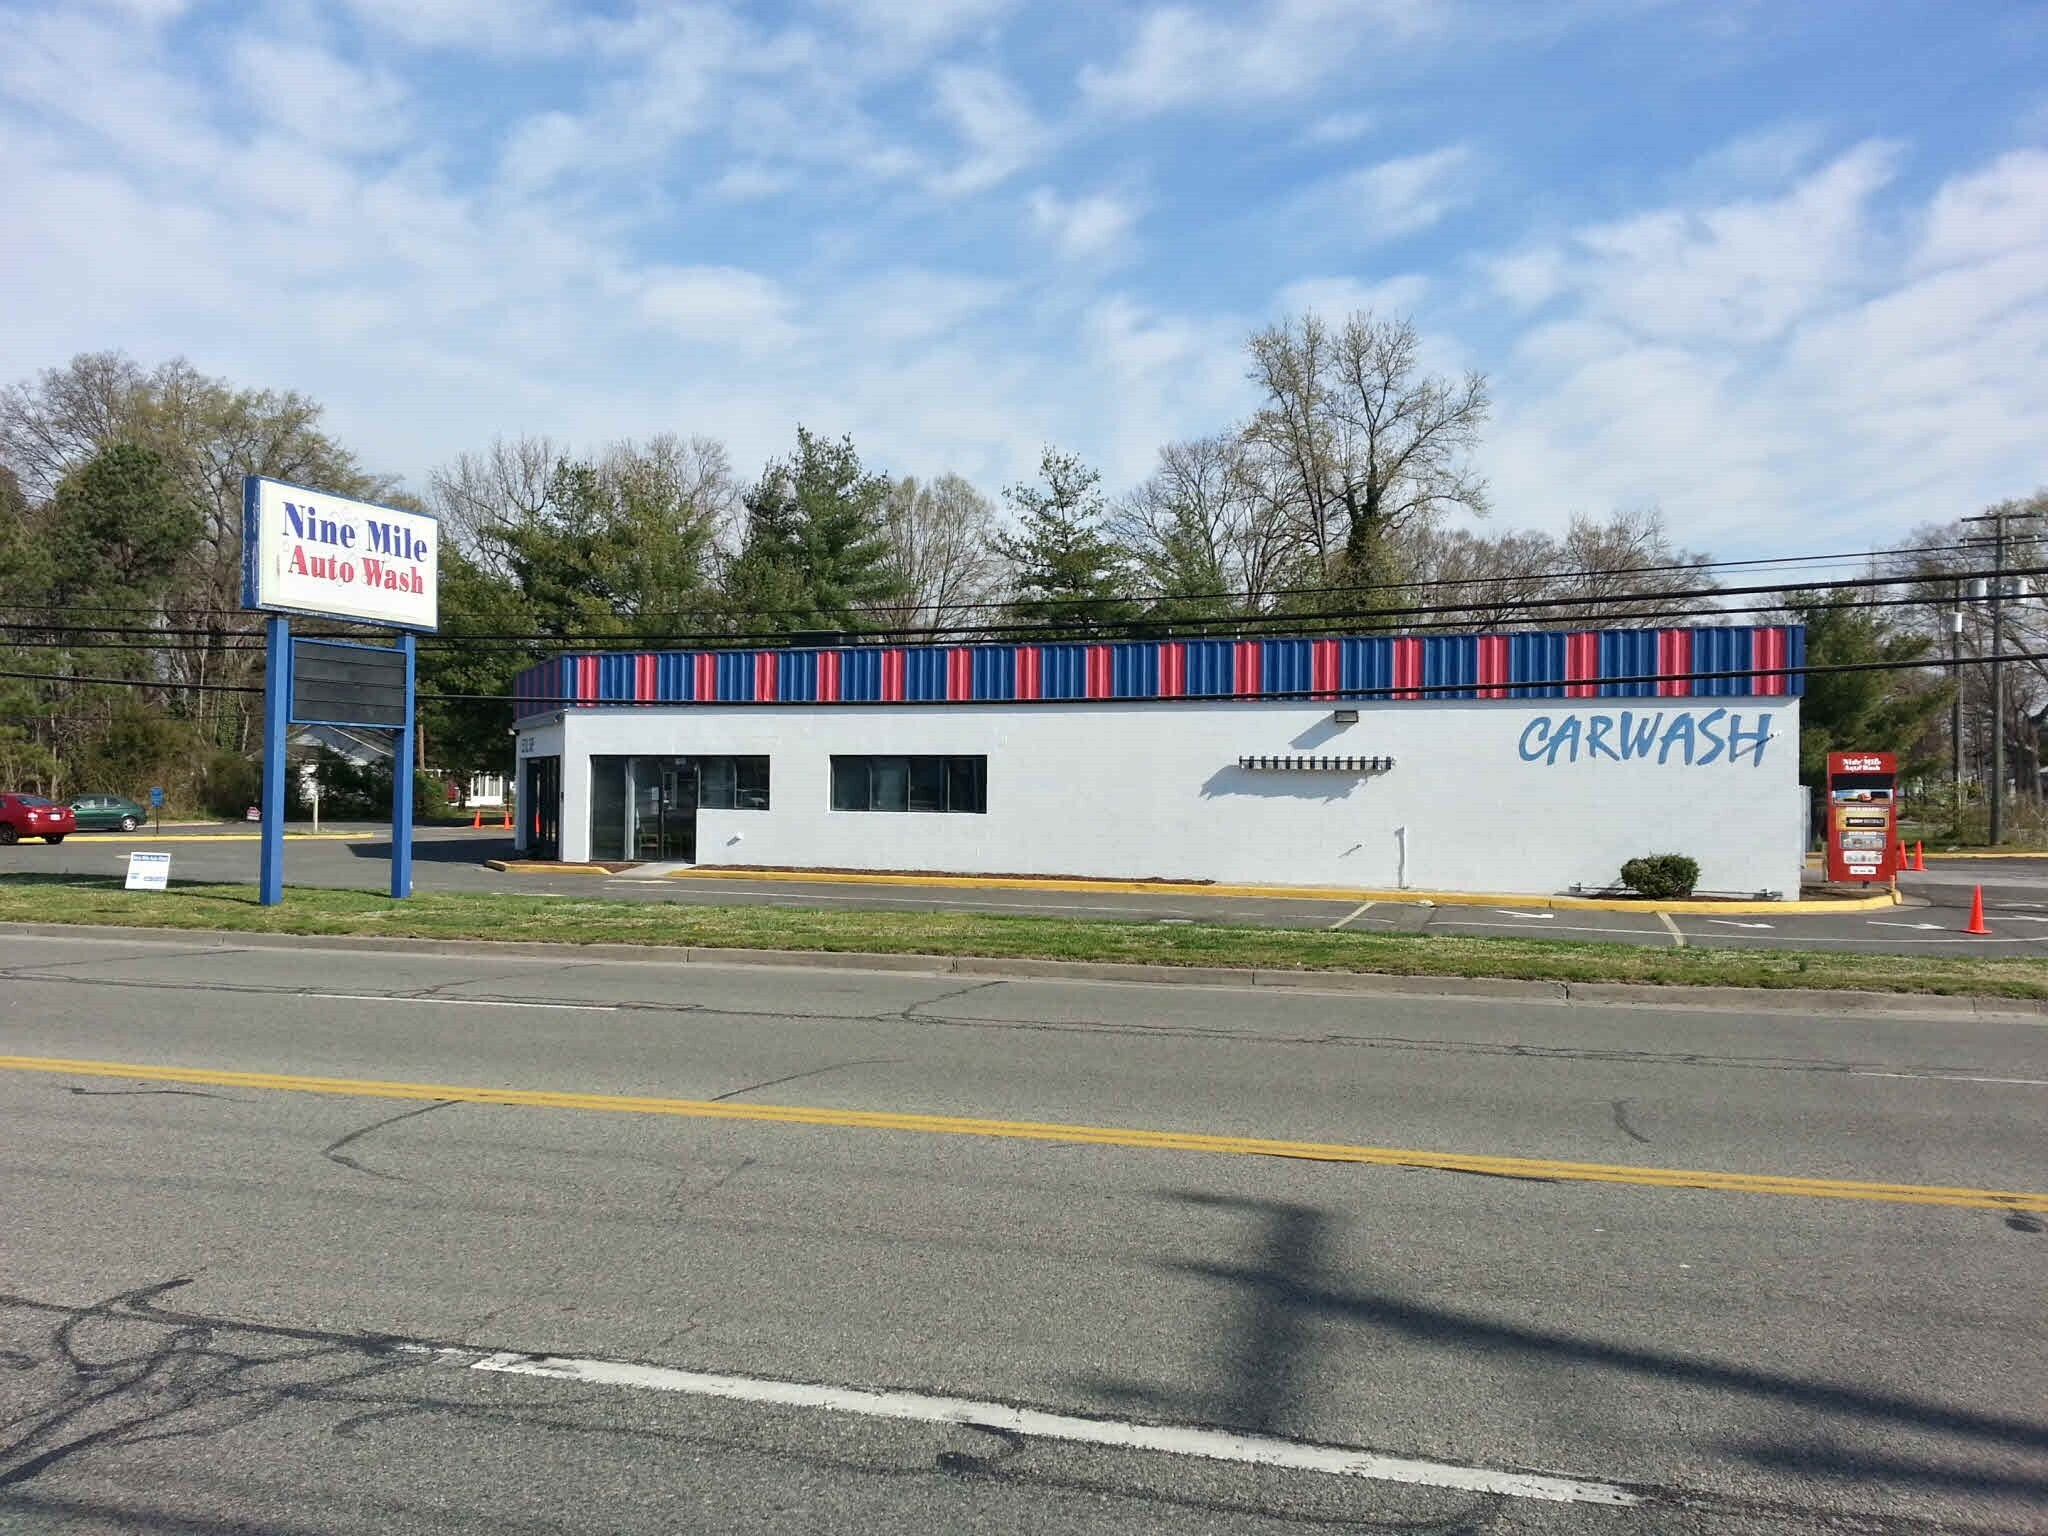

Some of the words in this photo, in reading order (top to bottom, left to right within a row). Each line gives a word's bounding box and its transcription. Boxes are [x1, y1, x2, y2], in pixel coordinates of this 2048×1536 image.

[282, 502, 355, 548] Nine
[366, 520, 427, 562] Mile
[288, 545, 354, 583] Auto
[362, 557, 424, 595] Wash
[1519, 708, 1772, 767] CARWASH
